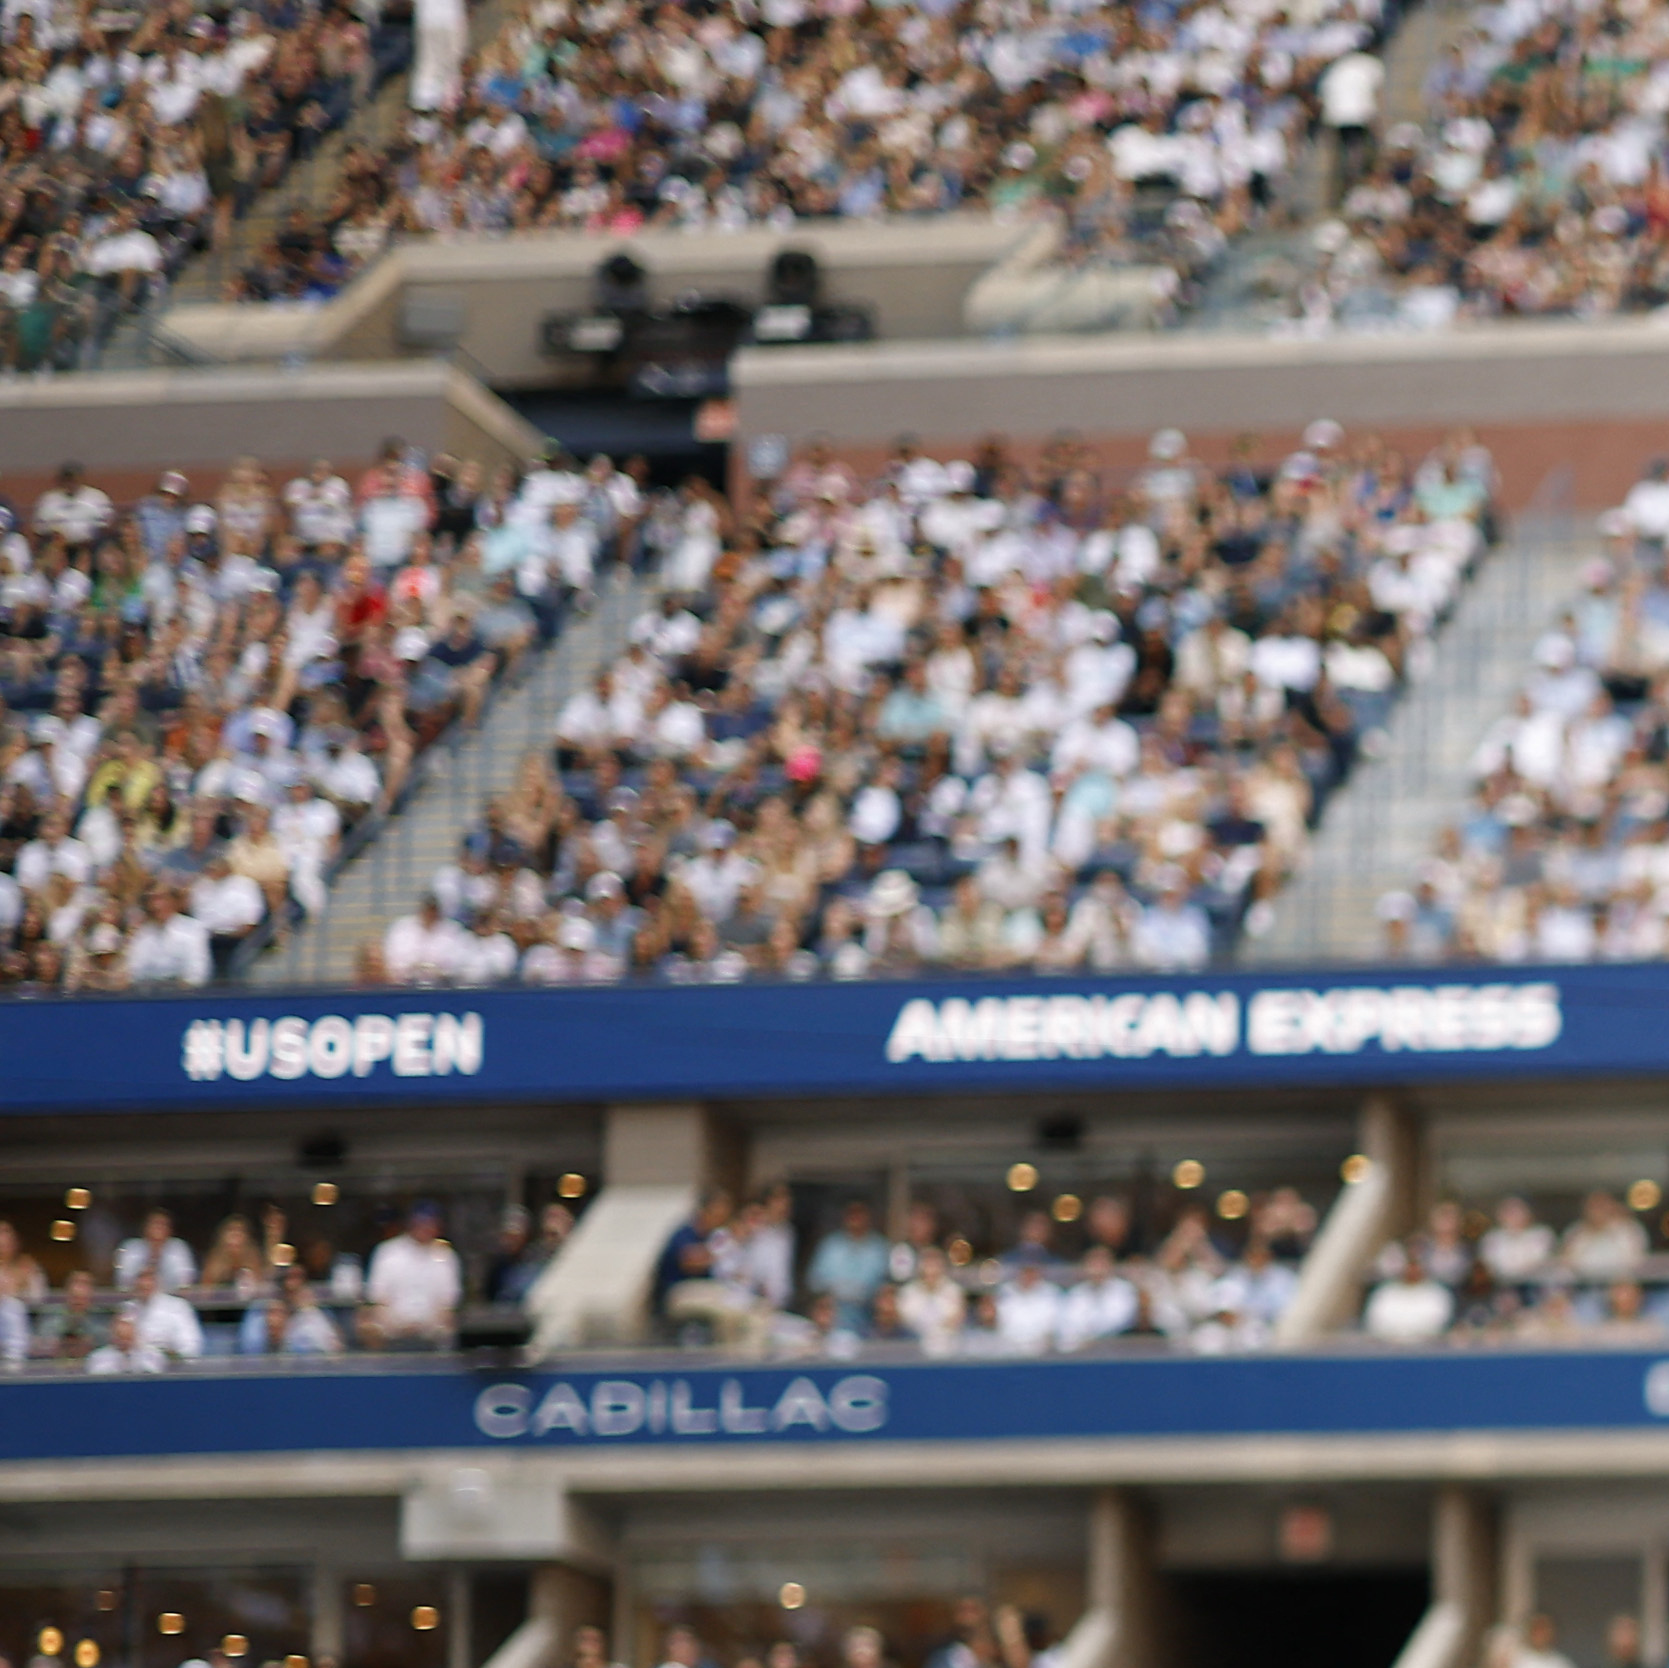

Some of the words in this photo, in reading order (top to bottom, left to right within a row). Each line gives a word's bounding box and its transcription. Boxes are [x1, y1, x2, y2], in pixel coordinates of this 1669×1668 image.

[182, 1011, 484, 1081] #USOPEN
[887, 992, 1239, 1063] AMERICAN
[1247, 983, 1562, 1056] EXPRESS
[474, 1374, 888, 1438] CADILLAC
